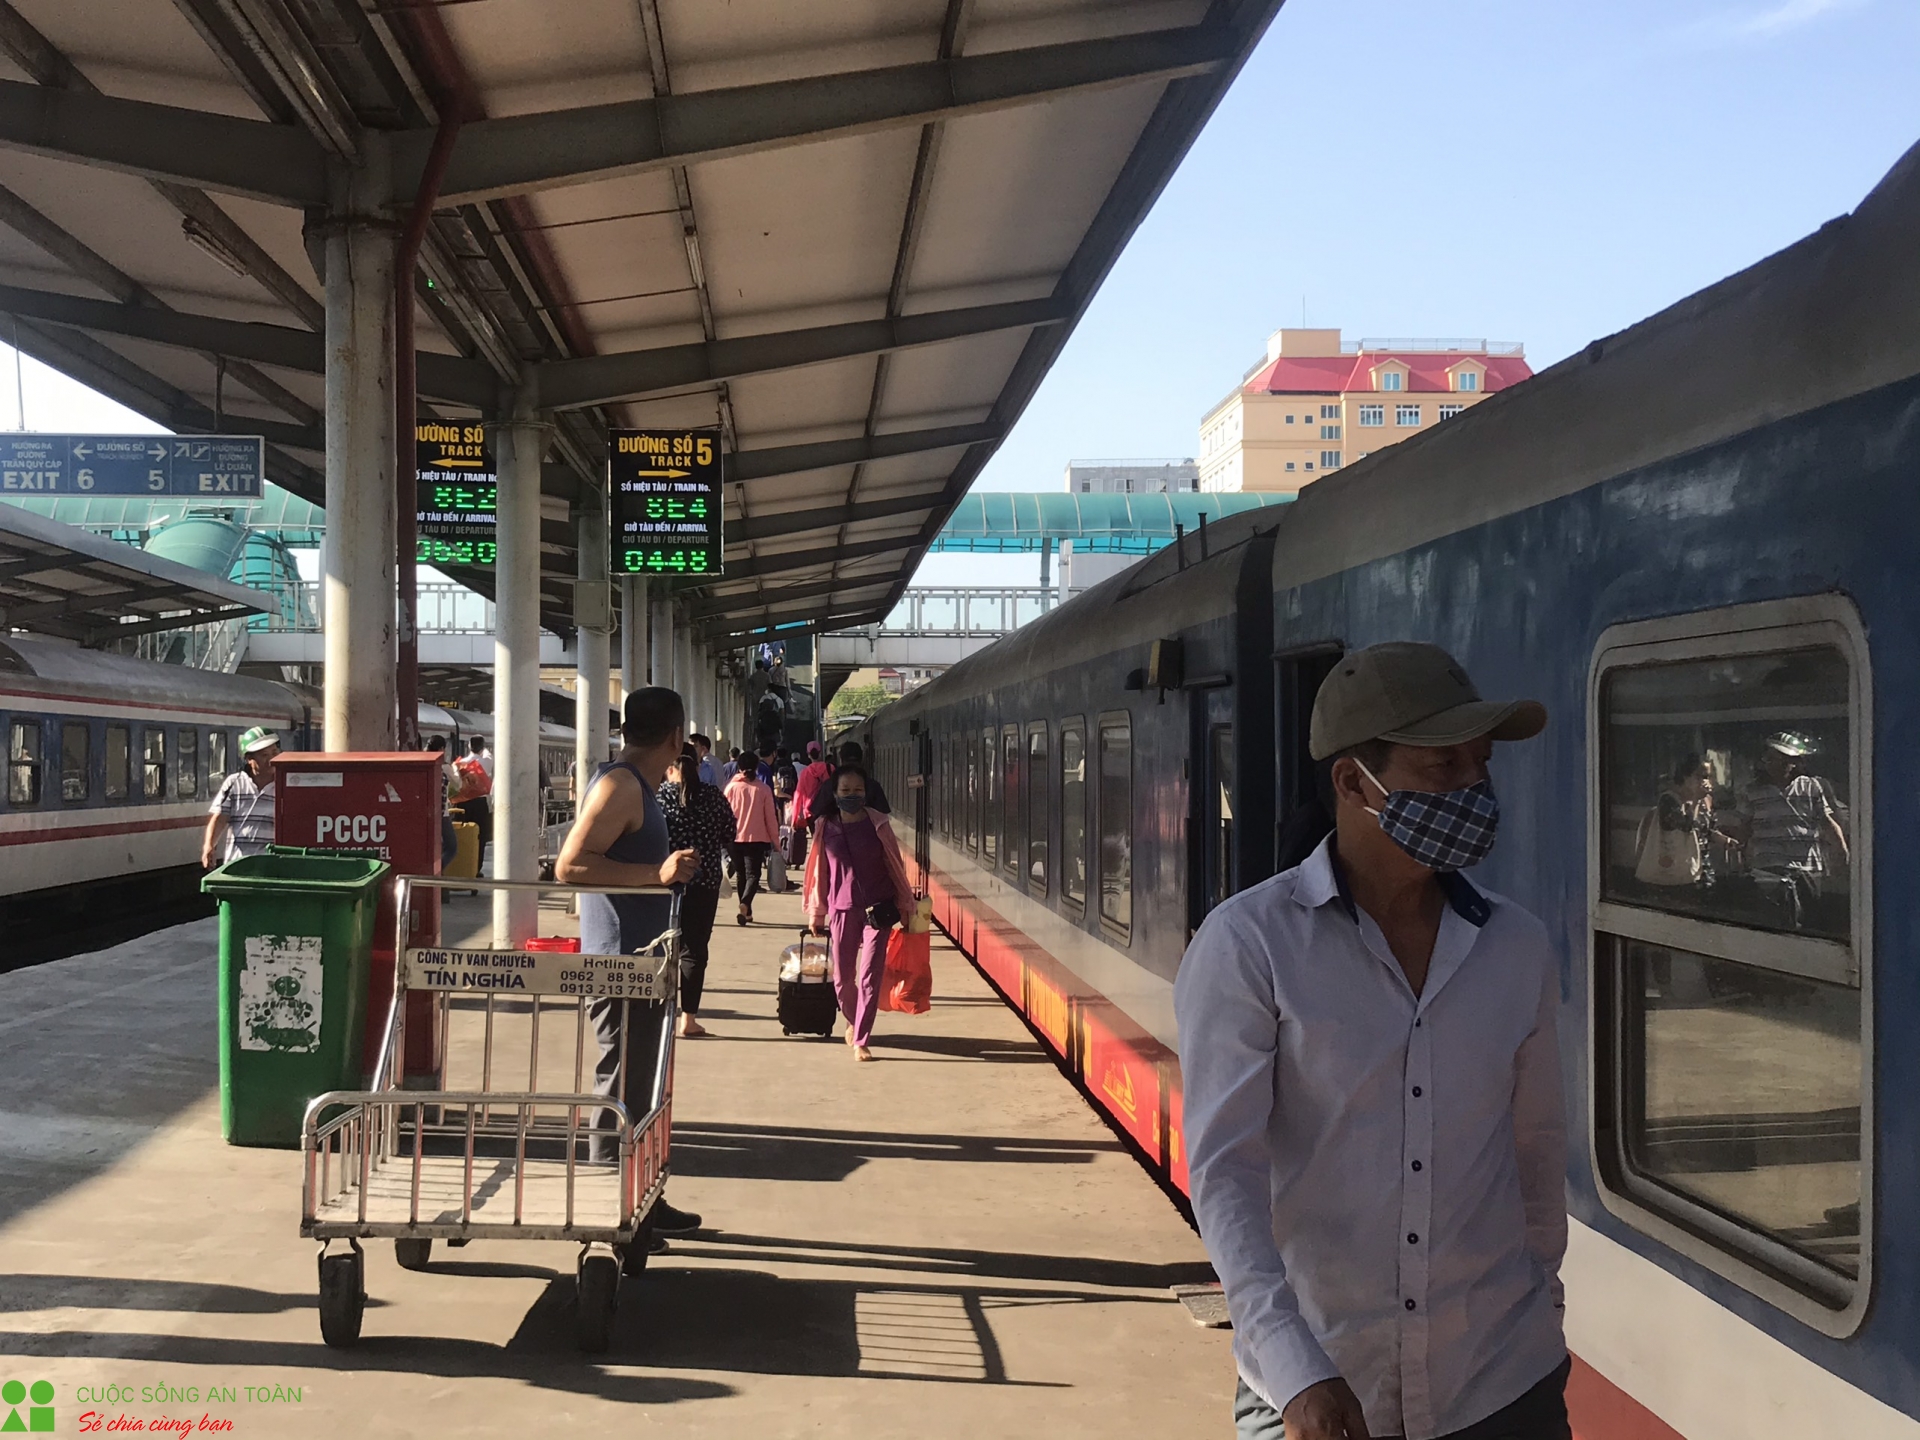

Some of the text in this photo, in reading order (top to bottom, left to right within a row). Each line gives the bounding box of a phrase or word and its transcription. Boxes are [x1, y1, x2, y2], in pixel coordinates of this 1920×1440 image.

[464, 423, 484, 444] SỐ
[440, 444, 482, 456] TRACK
[618, 432, 712, 466] ĐƯỜNG SỐ 5
[650, 456, 692, 466] TRACK
[3, 471, 60, 490] EXIT
[77, 468, 95, 490] 6
[148, 470, 166, 490] 5
[422, 470, 440, 482] HIỆU
[441, 471, 456, 481] TÀU
[464, 473, 486, 482] TRAIN
[199, 474, 256, 492] EXIT
[621, 480, 632, 492] SỐ
[633, 482, 650, 493] HIỆU
[652, 480, 667, 492] TÀU
[674, 483, 696, 492] TRAIN
[426, 511, 442, 522] TÀU
[443, 510, 458, 522] ĐẾN
[465, 514, 497, 523] ARRIVAL
[624, 521, 638, 532] GIỜ
[639, 522, 654, 532] TÀU
[655, 521, 671, 532] ĐẾN
[677, 524, 708, 533] ARRIVAL
[668, 536, 710, 544] DEPARTURE
[316, 814, 387, 843] PCCC
[417, 950, 448, 965] CÔNG
[451, 953, 463, 966] TY
[583, 958, 635, 970] Hotline
[424, 967, 526, 989] TÍN NGHĨA
[560, 970, 594, 981] 0962
[628, 973, 654, 983] 968
[560, 983, 652, 996] 0913 213 716
